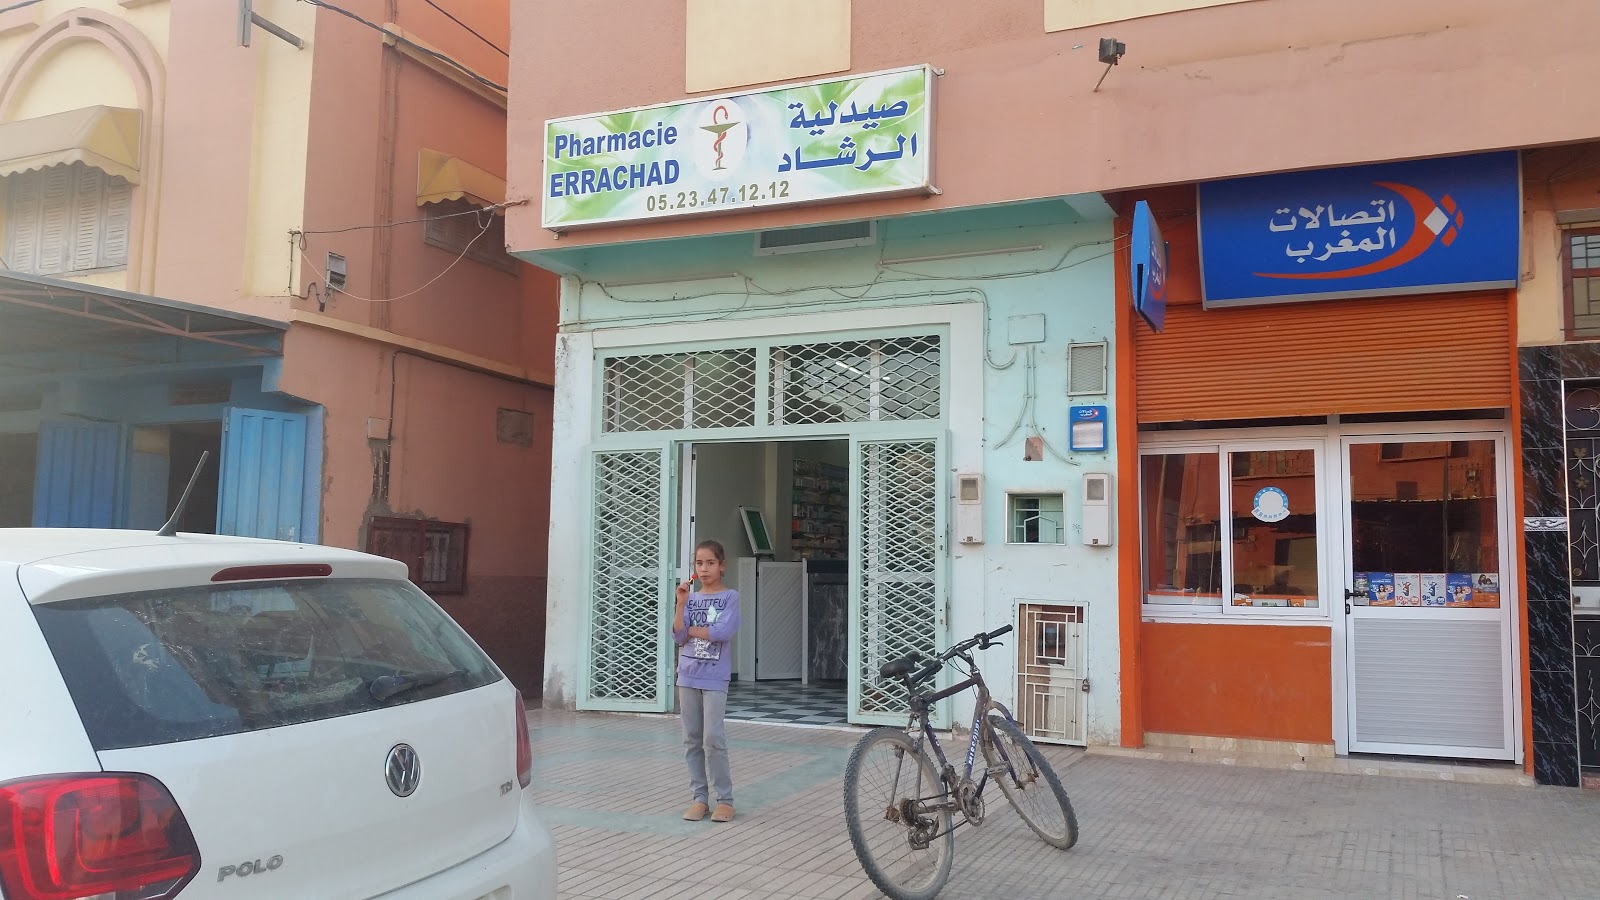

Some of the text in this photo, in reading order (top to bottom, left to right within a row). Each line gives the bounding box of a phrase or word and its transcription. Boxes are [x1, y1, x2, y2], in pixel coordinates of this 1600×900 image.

[787, 100, 909, 137] صيدلية
[554, 121, 678, 159] Pharmacie
[777, 131, 918, 173] الرشاد
[550, 159, 680, 197] ERRACHAD
[646, 180, 790, 212] 05.23.47.12.12
[1269, 199, 1395, 233] اتصالات
[1285, 225, 1396, 264] المغرب
[216, 854, 284, 883] POLO
